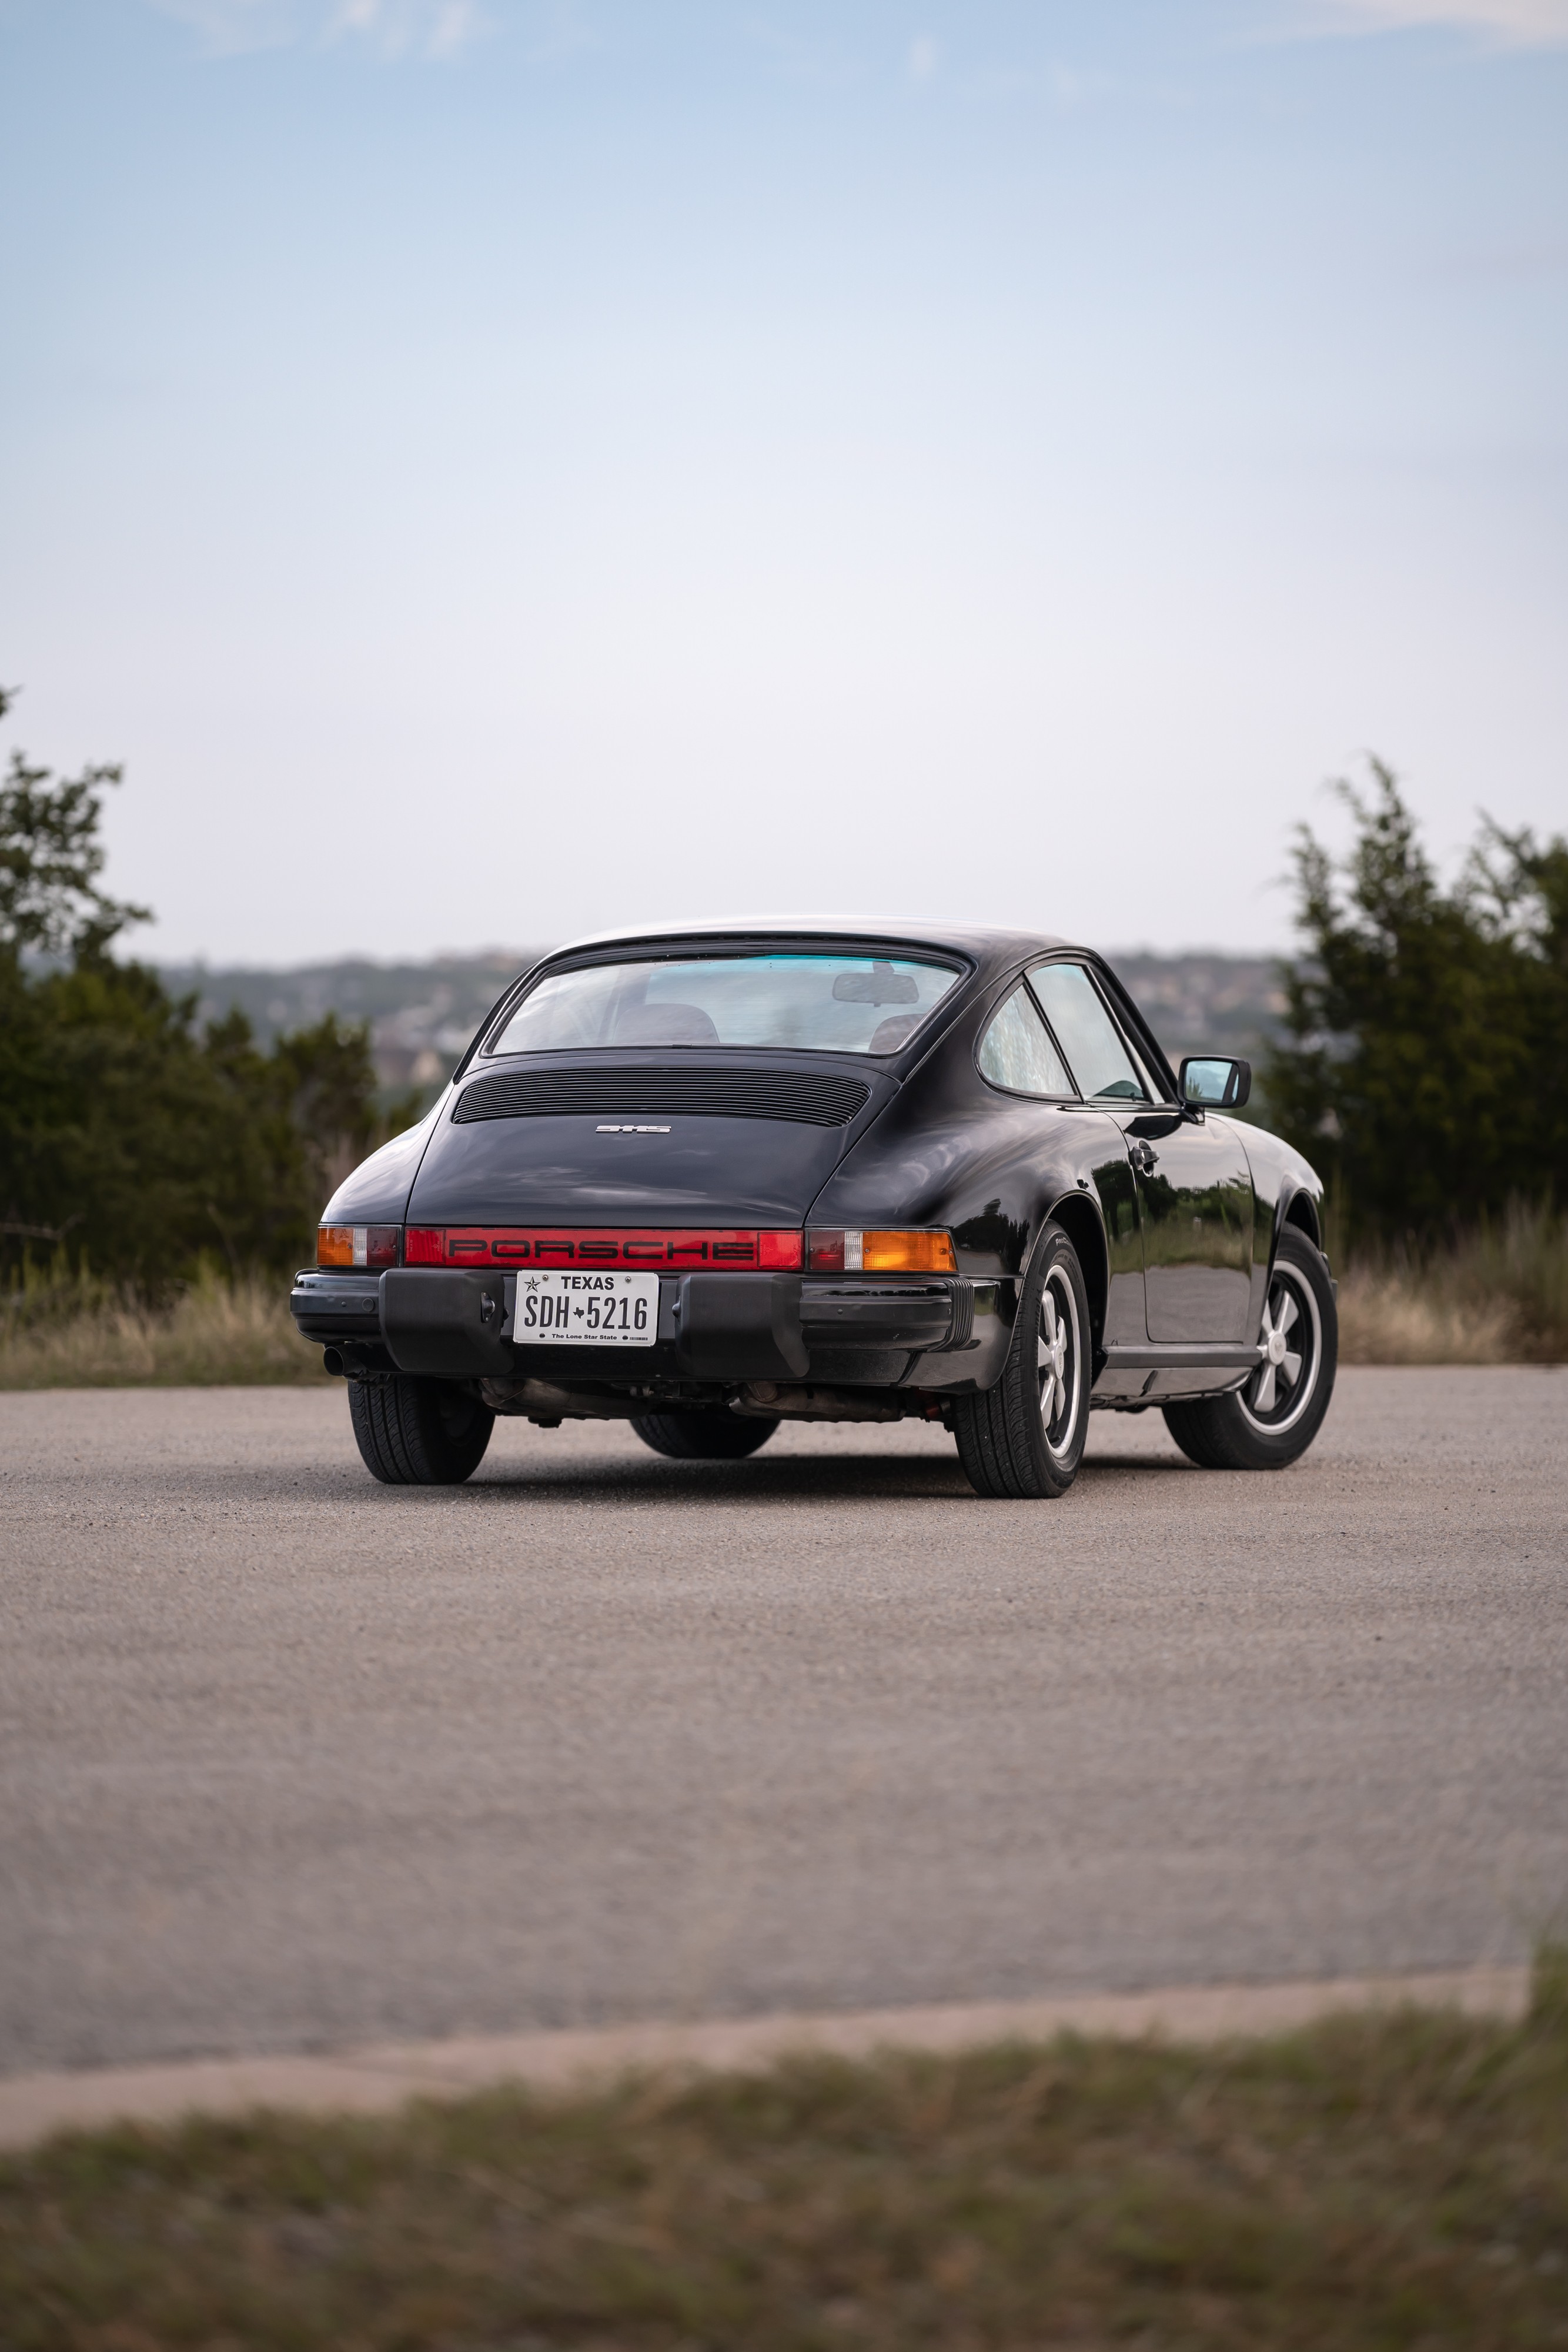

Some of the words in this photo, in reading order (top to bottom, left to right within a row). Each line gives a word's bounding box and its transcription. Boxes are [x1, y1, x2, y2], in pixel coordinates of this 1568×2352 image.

[596, 1125, 672, 1134] 911S
[449, 1239, 754, 1260] PORSCHE
[561, 1276, 614, 1290] TEXAS
[524, 1295, 570, 1328] SDH
[587, 1297, 647, 1330] 5216
